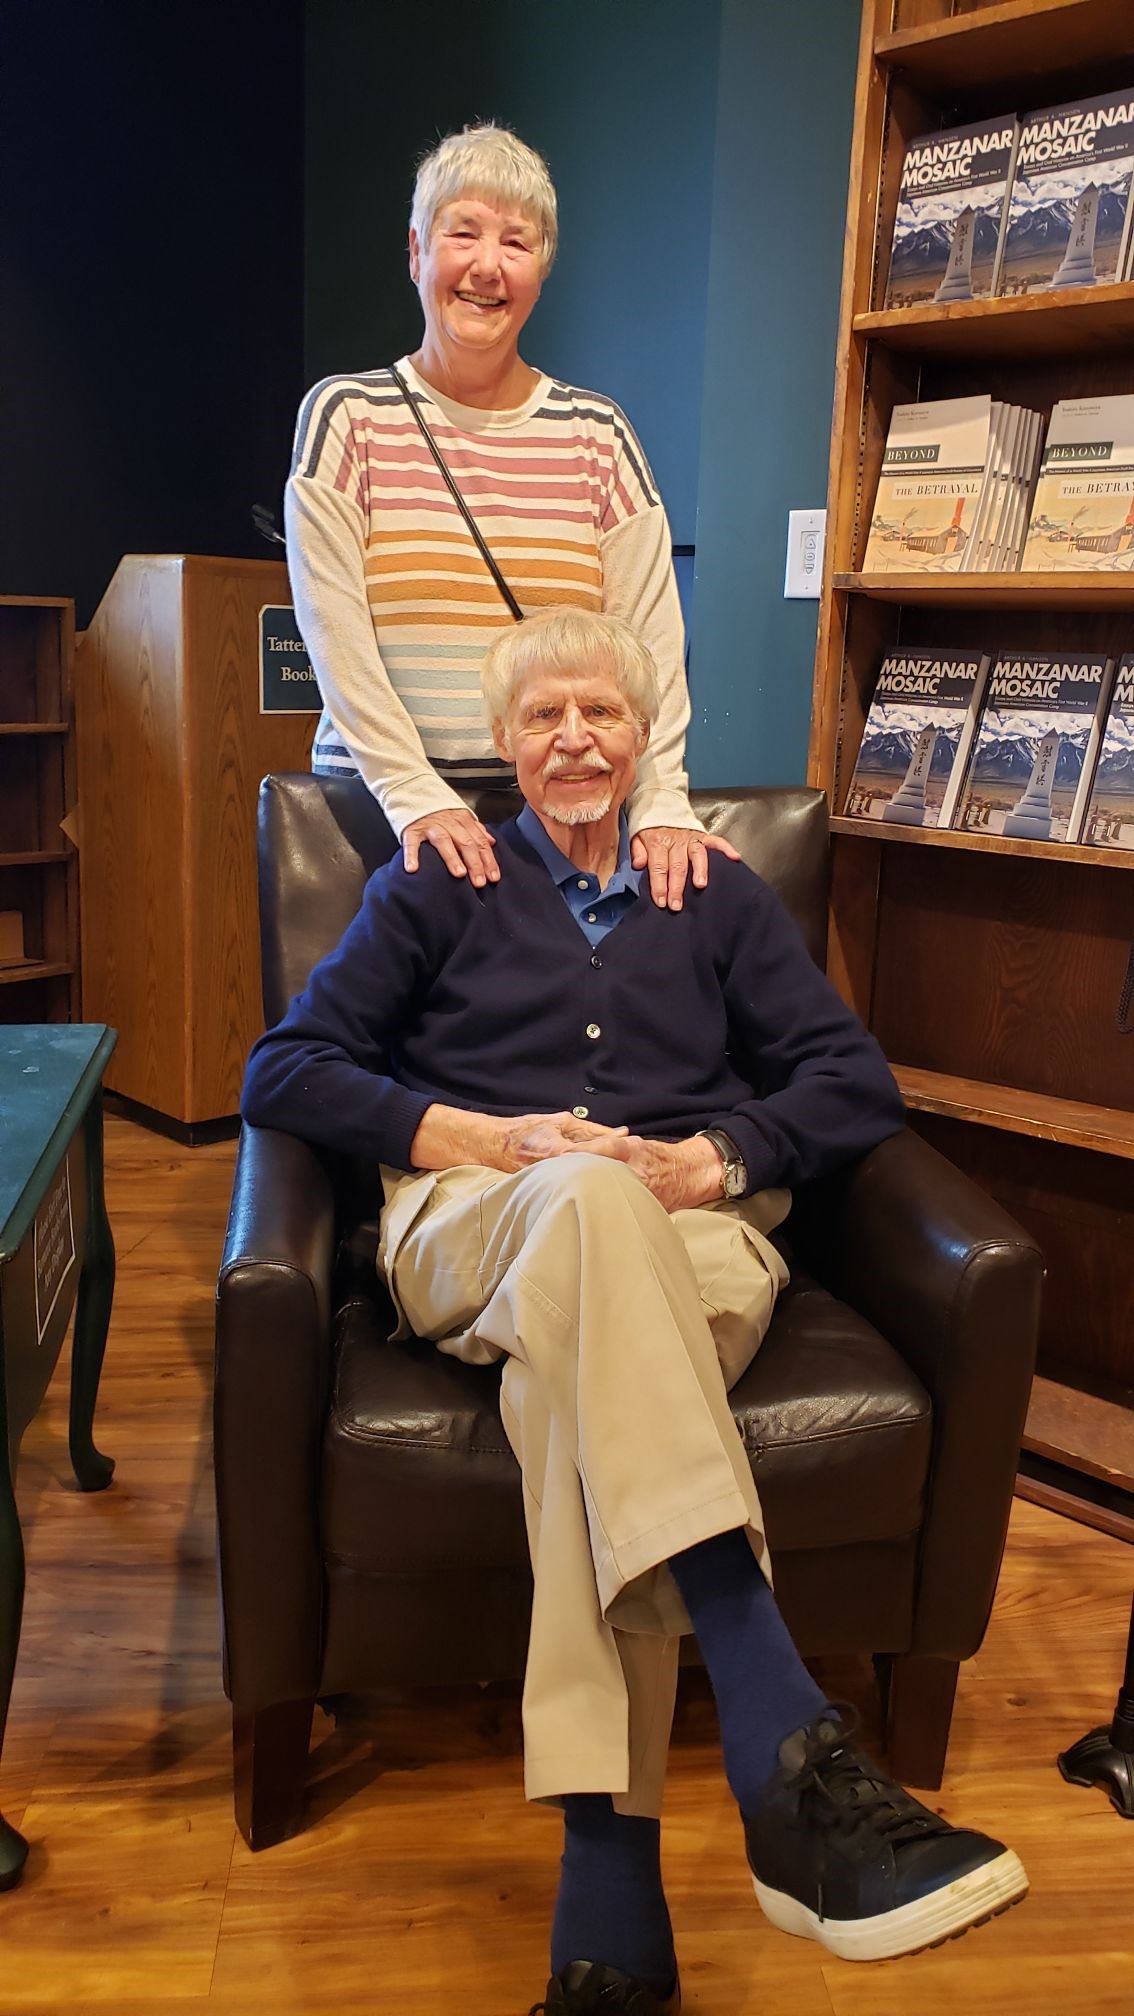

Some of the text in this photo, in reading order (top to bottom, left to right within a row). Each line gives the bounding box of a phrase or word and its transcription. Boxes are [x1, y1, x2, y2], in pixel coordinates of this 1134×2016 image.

[903, 129, 1014, 170] MANZANAR
[1016, 131, 1096, 166] MOSAIC
[900, 157, 972, 188] MOSAIC
[887, 448, 935, 461] BEYOND
[1052, 445, 1107, 458] BEYOND
[896, 483, 978, 496] THE BETRAYAL
[1063, 481, 1134, 495] THE BETRA
[880, 658, 978, 680] MANZANAR
[992, 661, 1103, 683] MANZANAR
[876, 675, 941, 695] MOSAIC
[988, 678, 1061, 699] MOSAIC
